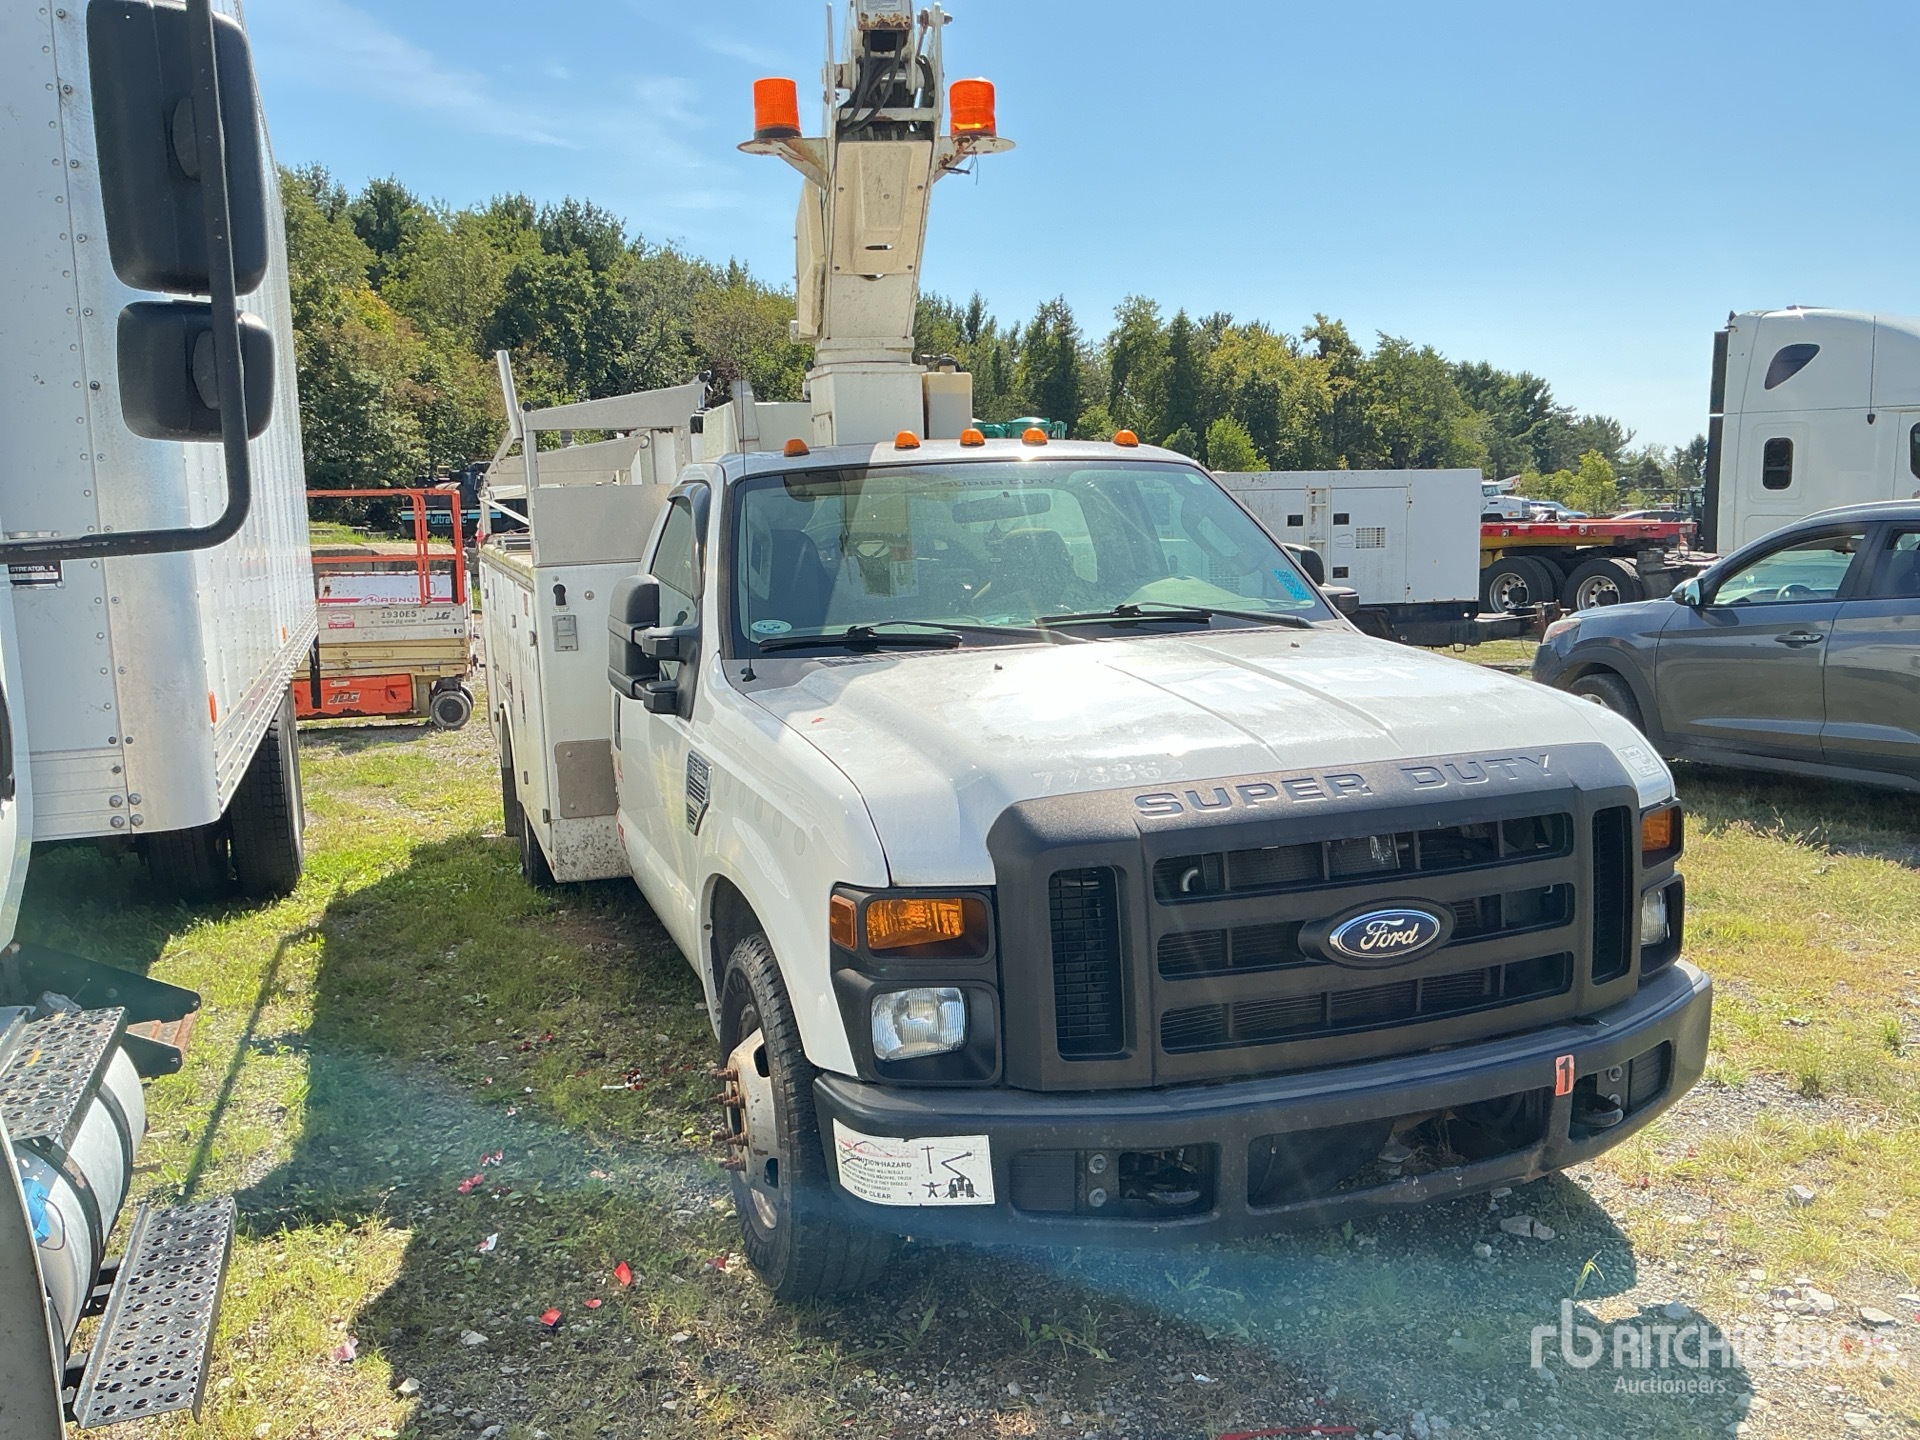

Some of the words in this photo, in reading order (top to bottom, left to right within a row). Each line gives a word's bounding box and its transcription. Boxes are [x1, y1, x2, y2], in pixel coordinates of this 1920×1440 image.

[430, 512, 468, 524] ultrac
[380, 610, 417, 619] 1930ES
[328, 690, 361, 705] JLG
[1134, 773, 1374, 819] SUPER
[1401, 754, 1554, 791] DUTY
[1360, 918, 1419, 951] Ford
[1558, 1057, 1570, 1093] 1
[853, 1185, 868, 1194] KEEP
[868, 1190, 892, 1199] CLEAR
